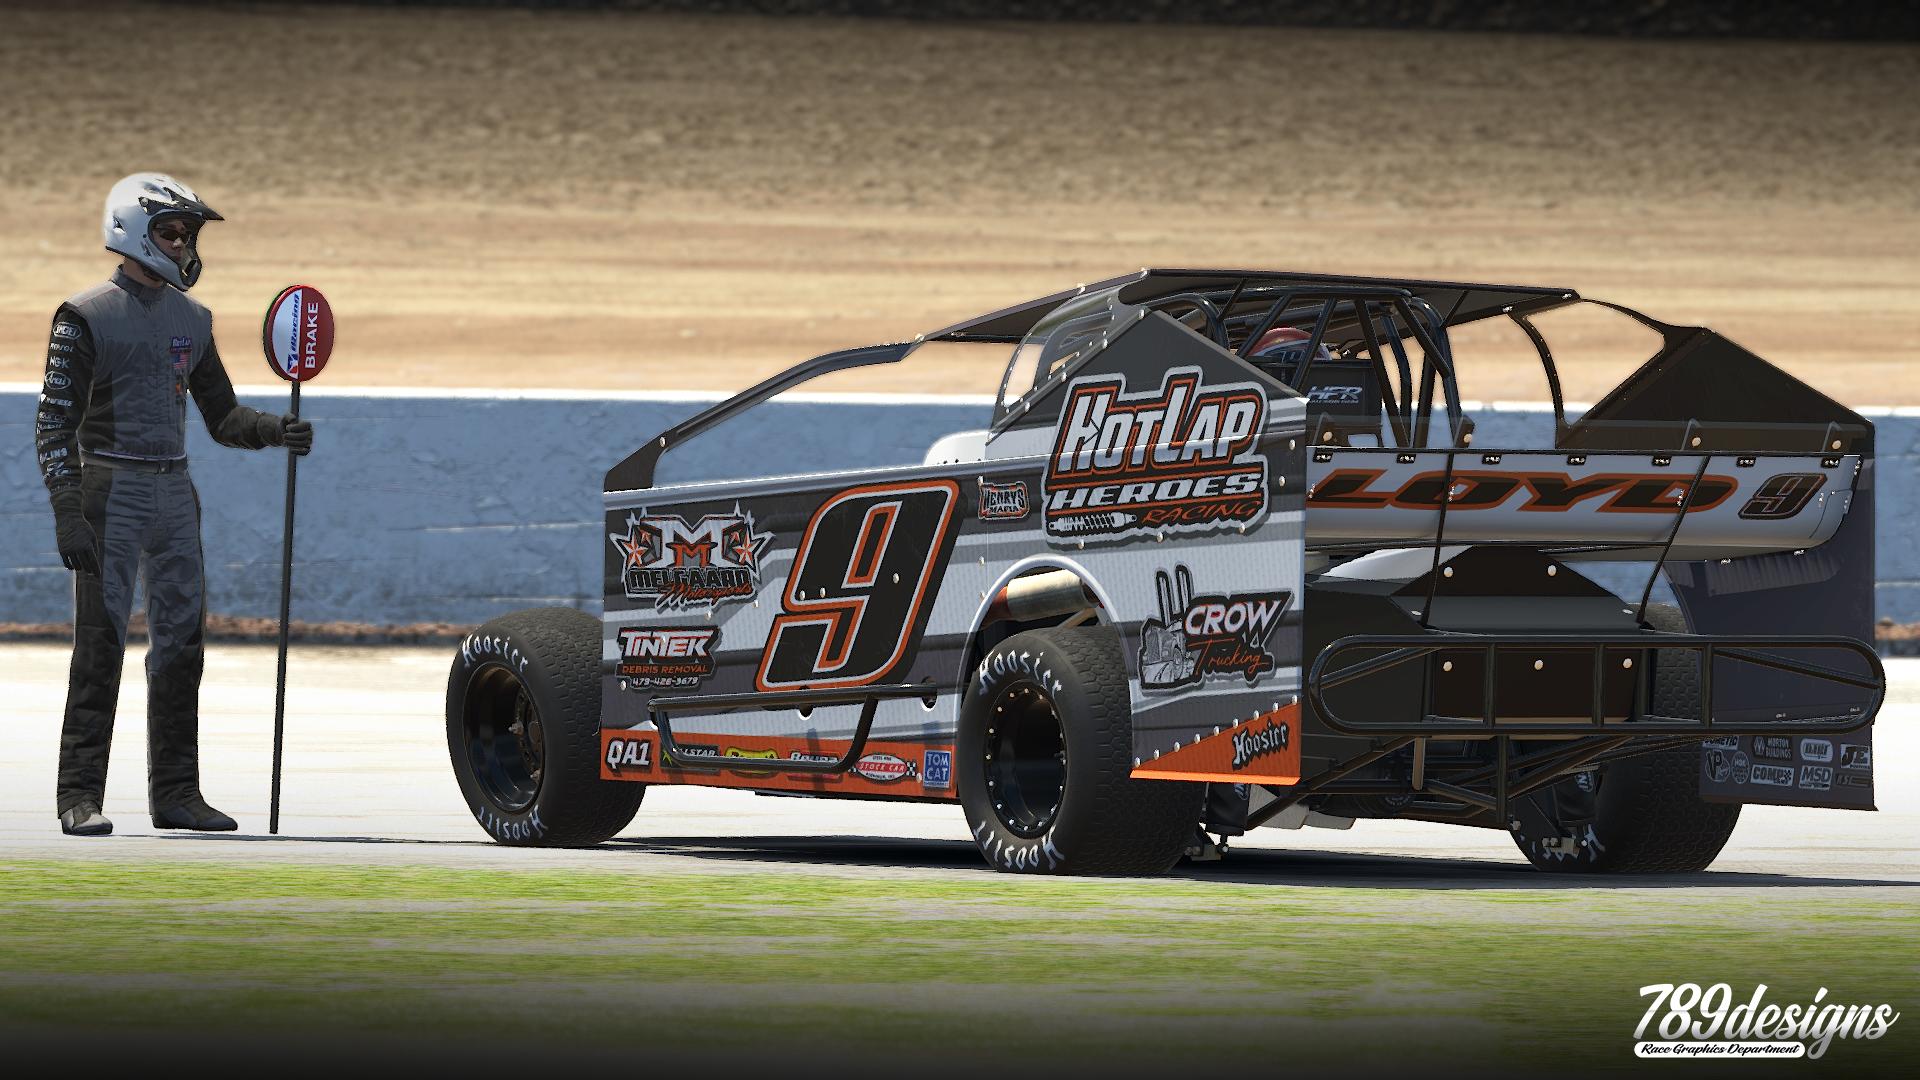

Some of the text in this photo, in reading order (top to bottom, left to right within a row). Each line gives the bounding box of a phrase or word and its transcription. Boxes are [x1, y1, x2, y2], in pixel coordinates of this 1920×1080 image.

[305, 303, 318, 368] BRAKE
[1050, 474, 1261, 510] HEROES
[1307, 467, 1828, 520] LOYD 9
[1142, 501, 1262, 523] RACING
[756, 480, 960, 693] 9
[1185, 600, 1277, 635] CROW
[620, 631, 714, 657] TINTEK
[1187, 633, 1270, 675] Trucking
[622, 664, 708, 674] DEBRIS REMOVAL
[606, 739, 650, 770] QA1
[927, 753, 949, 766] TOM
[1233, 722, 1287, 766] Hoosier
[859, 763, 905, 772] STOCK CAR
[926, 767, 948, 780] CAT
[1801, 766, 1831, 782] MSD
